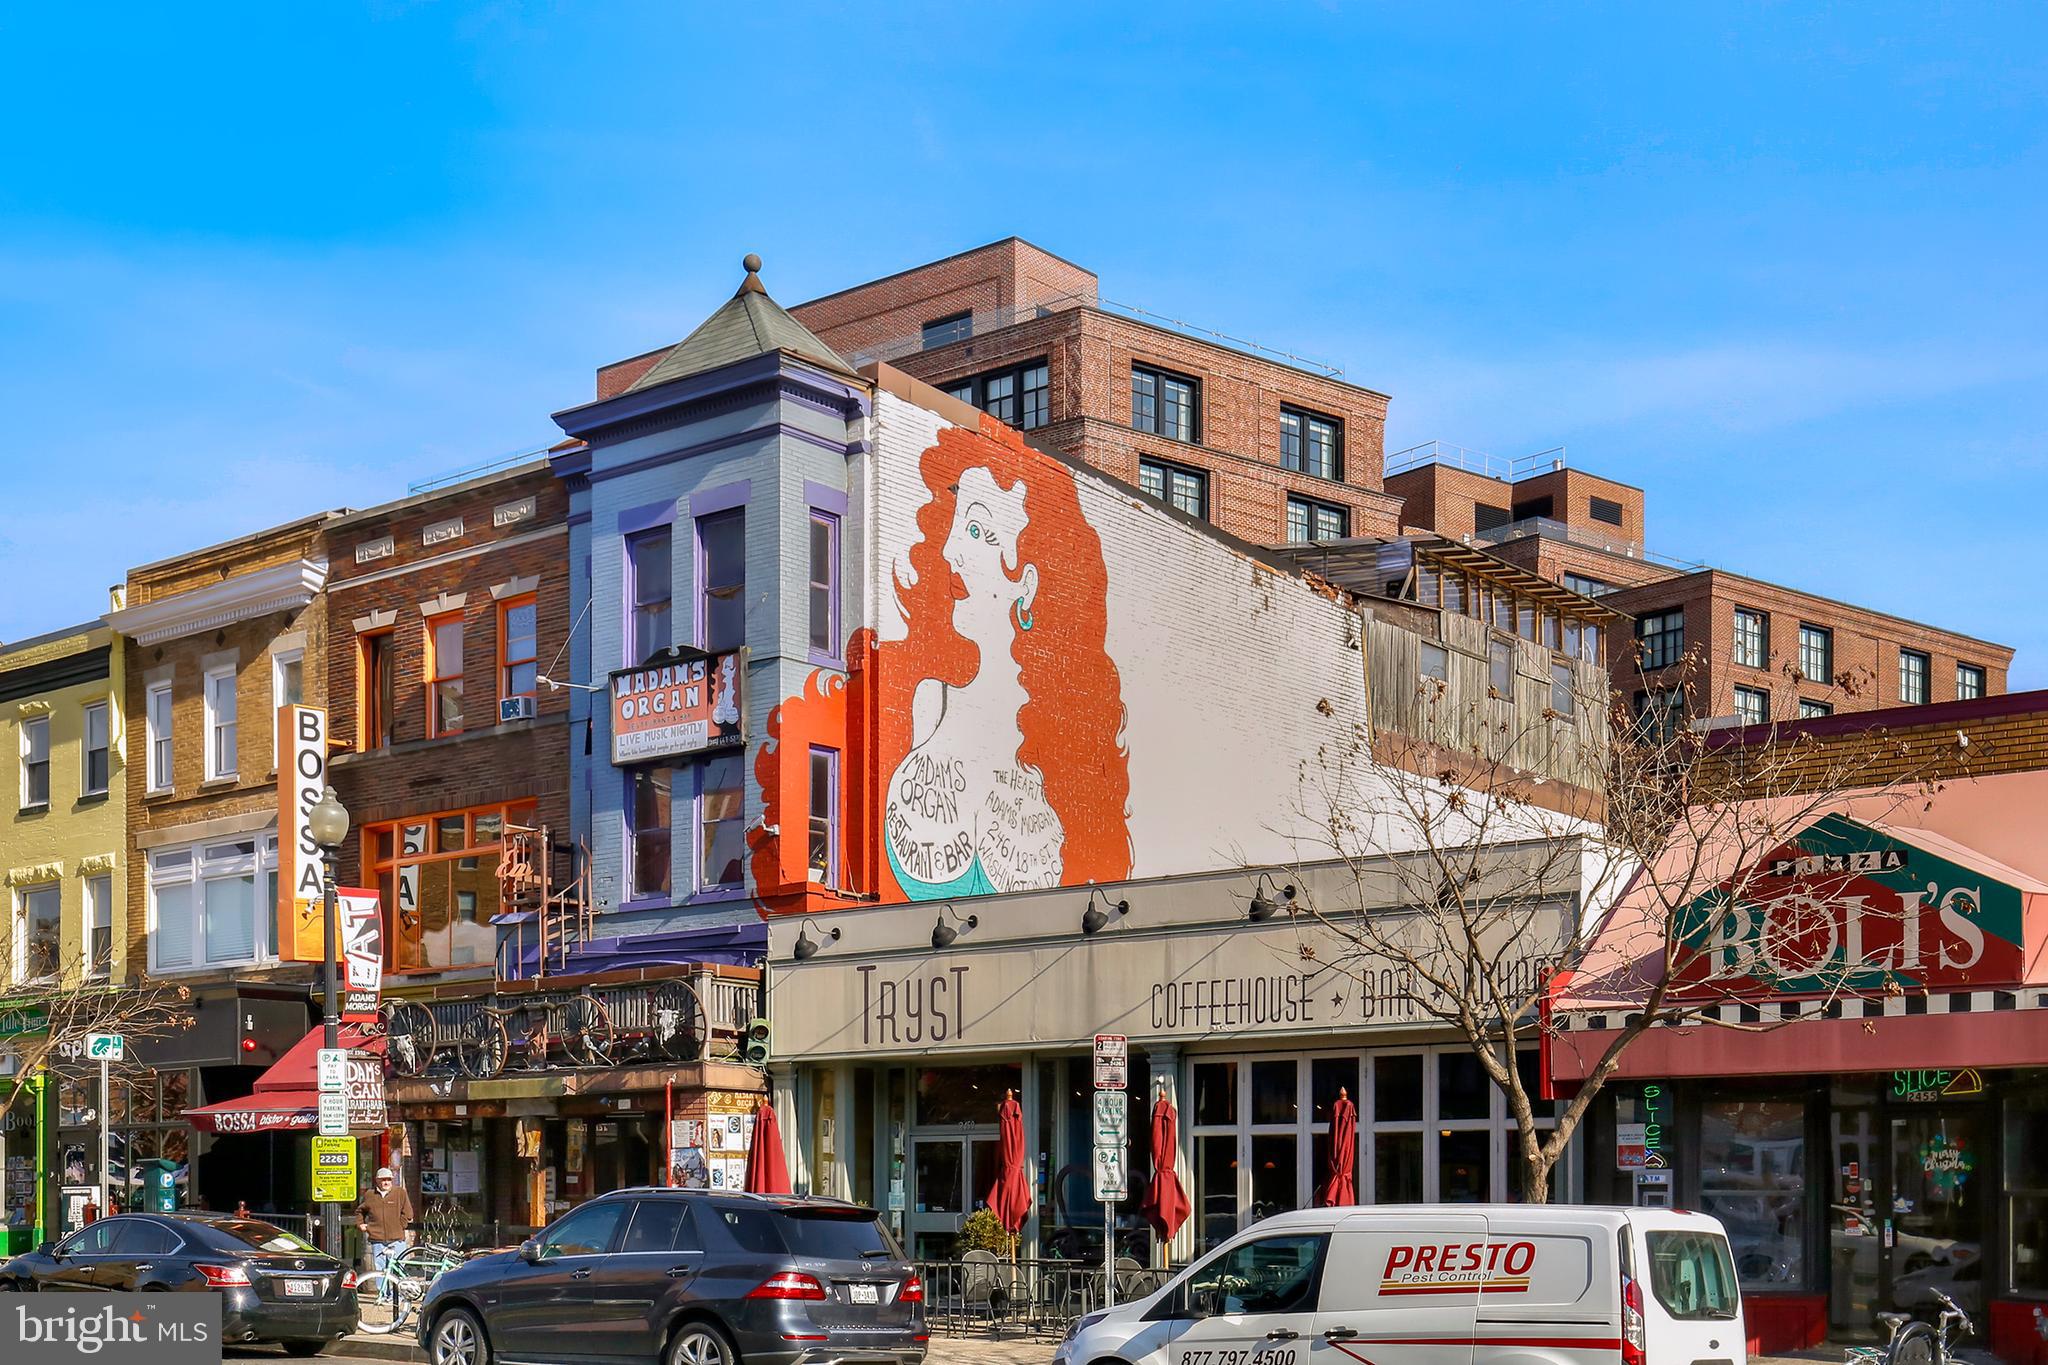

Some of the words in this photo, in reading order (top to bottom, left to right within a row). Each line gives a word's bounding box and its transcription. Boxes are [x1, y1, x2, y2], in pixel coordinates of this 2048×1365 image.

[616, 660, 704, 699] MADAM'S
[621, 684, 699, 720] ORGAN
[619, 734, 640, 747] LIVE
[644, 727, 667, 743] MUSIC
[670, 721, 703, 738] NIGHTLY
[902, 753, 966, 792] MADAM'S
[993, 770, 1008, 784] THE
[1010, 769, 1041, 801] HEART
[298, 711, 323, 894] BOSSA
[901, 779, 959, 824] ORGAN
[985, 790, 1018, 829] ADAMS
[1020, 810, 1056, 836] MORGAN
[1015, 798, 1023, 811] OF
[887, 801, 935, 879] RESTAURANT
[944, 831, 973, 873] BAR
[1776, 851, 1901, 877] PIZZA
[1702, 881, 1985, 980] BOLI'S
[345, 1002, 377, 1012] MORGAN
[348, 993, 376, 1002] ADAMS
[857, 965, 969, 1044] TRYST
[1152, 975, 1313, 1028] COFFEEHOUSE
[1361, 967, 1414, 1018] BAR
[347, 1062, 381, 1082] DAM'S
[1893, 1070, 1950, 1096] SLICE
[1098, 1097, 1103, 1105] 4
[1104, 1097, 1123, 1106] HOUR
[1908, 1091, 1937, 1101] 2455
[214, 1112, 257, 1131] BOSSA
[259, 1113, 284, 1126] bistro
[289, 1113, 319, 1126] galler
[1098, 1107, 1123, 1115] PARKING
[1644, 1085, 1661, 1149] SLICE
[320, 1155, 348, 1164] 22263
[1384, 1242, 1536, 1279] PRESTO
[1401, 1271, 1434, 1284] Pest
[1438, 1270, 1491, 1282] Control
[1181, 1349, 1297, 1365] 877.797.4500
